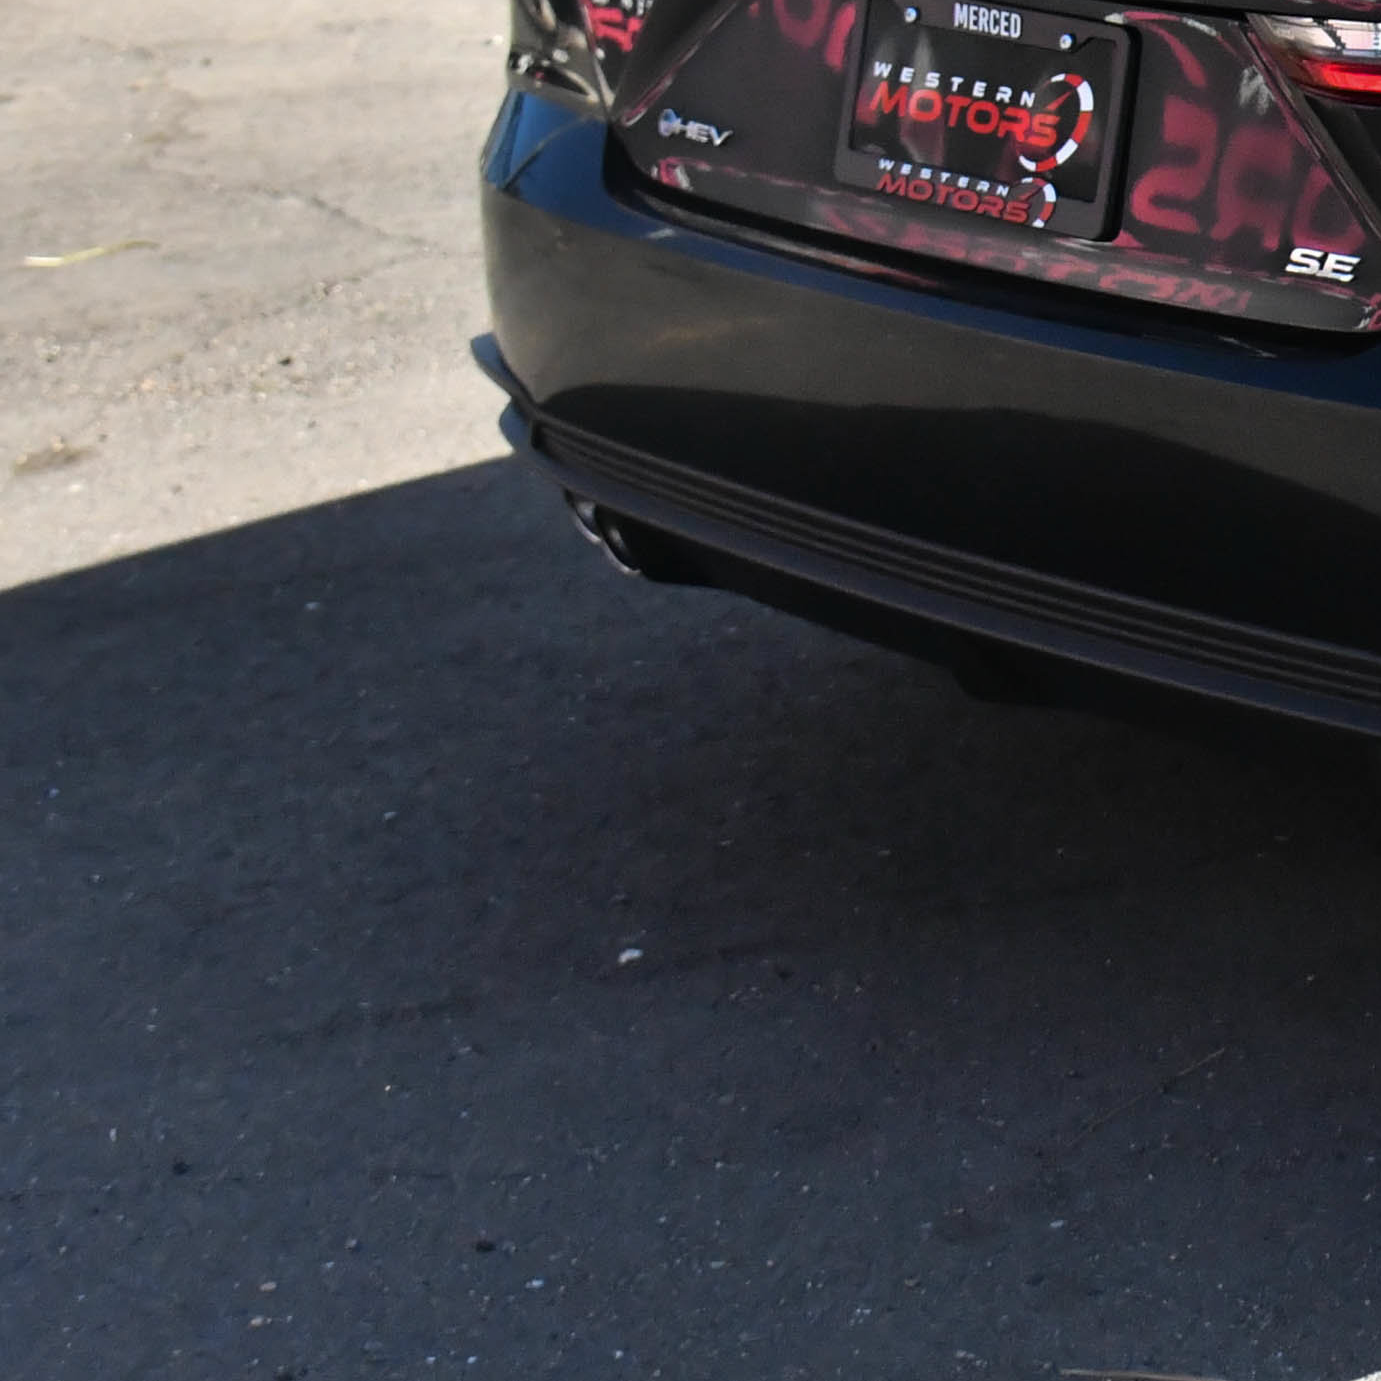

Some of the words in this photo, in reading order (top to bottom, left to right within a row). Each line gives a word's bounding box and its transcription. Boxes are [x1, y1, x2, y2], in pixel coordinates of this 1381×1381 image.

[953, 2, 1022, 39] MERCED
[873, 61, 1036, 108] WESTERN
[869, 81, 1061, 147] MOTORS
[876, 173, 1030, 224] MOTORS
[877, 158, 1010, 197] WESTERN
[1285, 247, 1361, 283] SE
